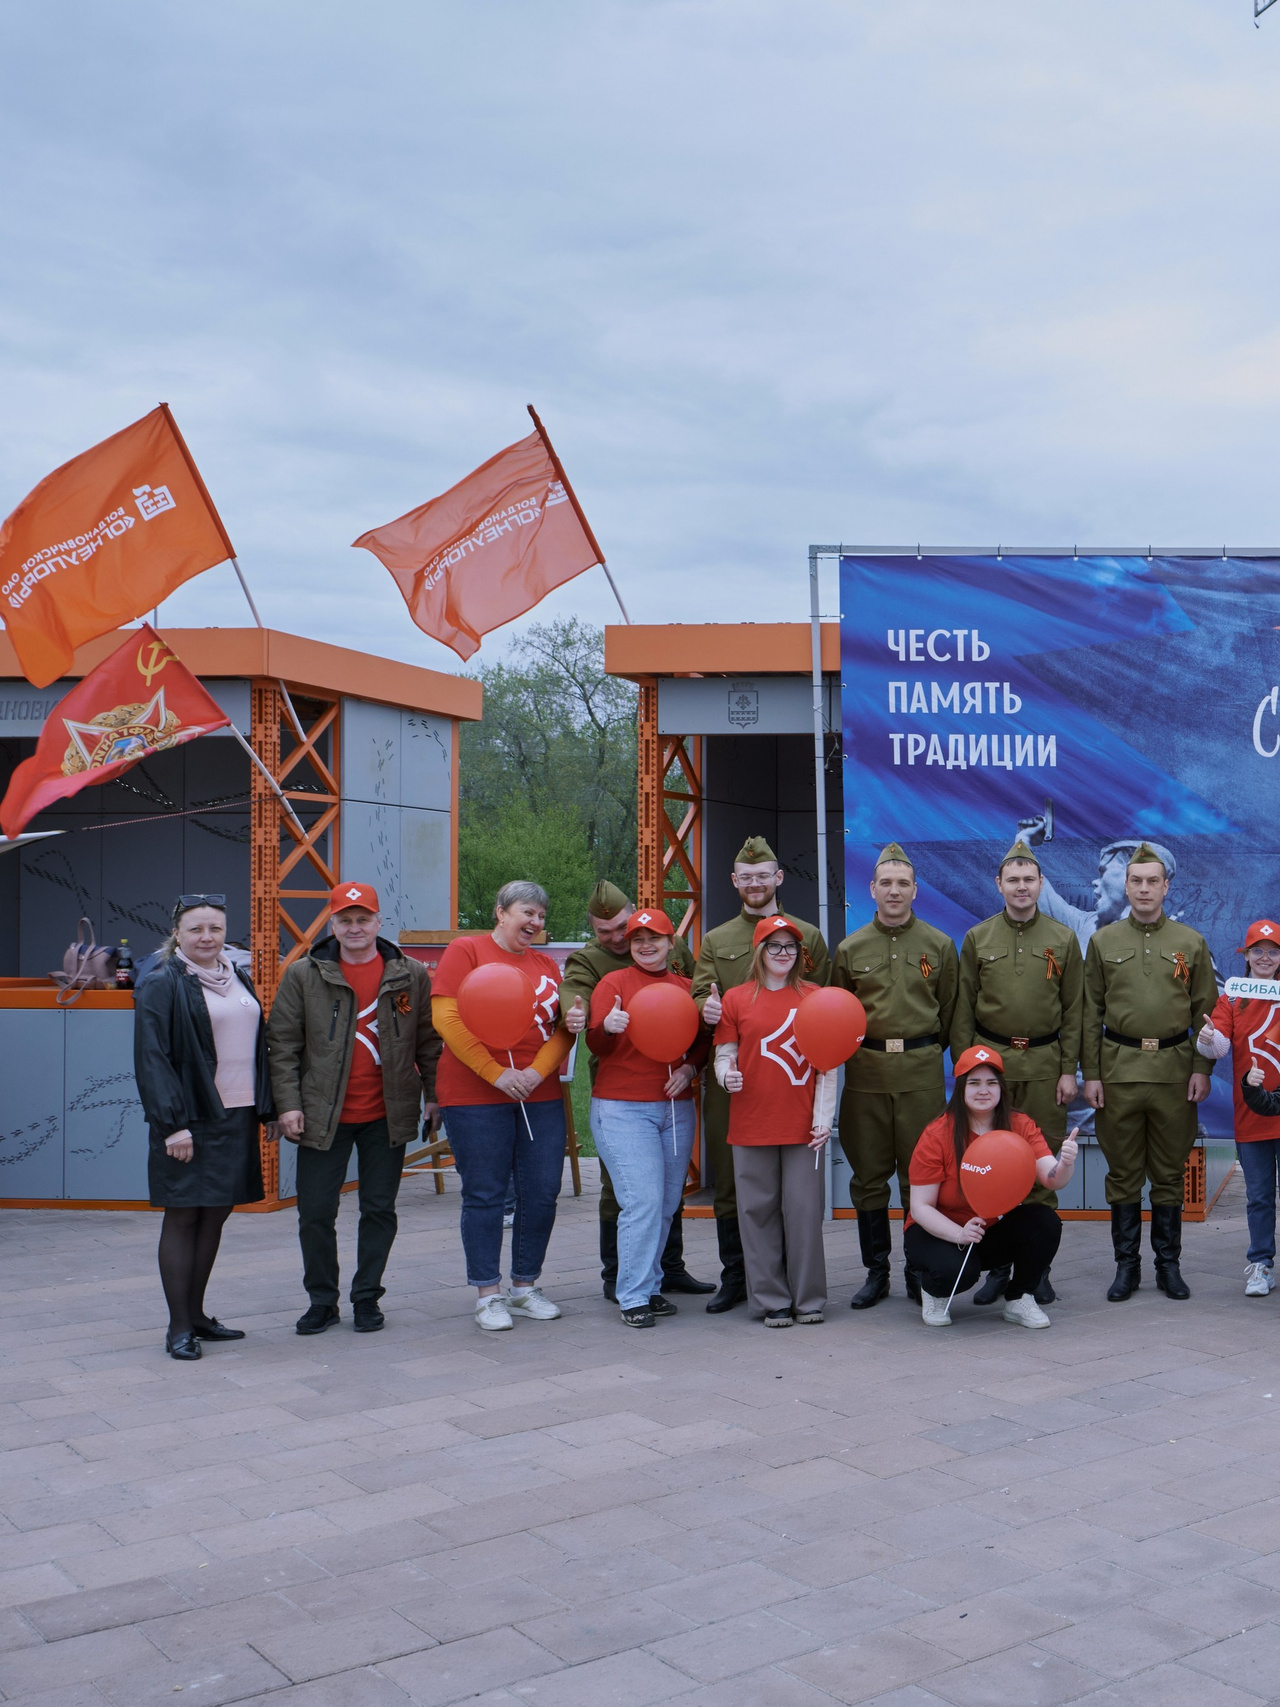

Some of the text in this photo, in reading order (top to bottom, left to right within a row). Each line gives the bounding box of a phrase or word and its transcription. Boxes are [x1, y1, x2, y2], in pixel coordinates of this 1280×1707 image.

[887, 629, 991, 661] ЧЕСТЬ
[888, 682, 1022, 714] ПАМЯТЬ
[889, 733, 1056, 770] ТРАДИЦИИ
